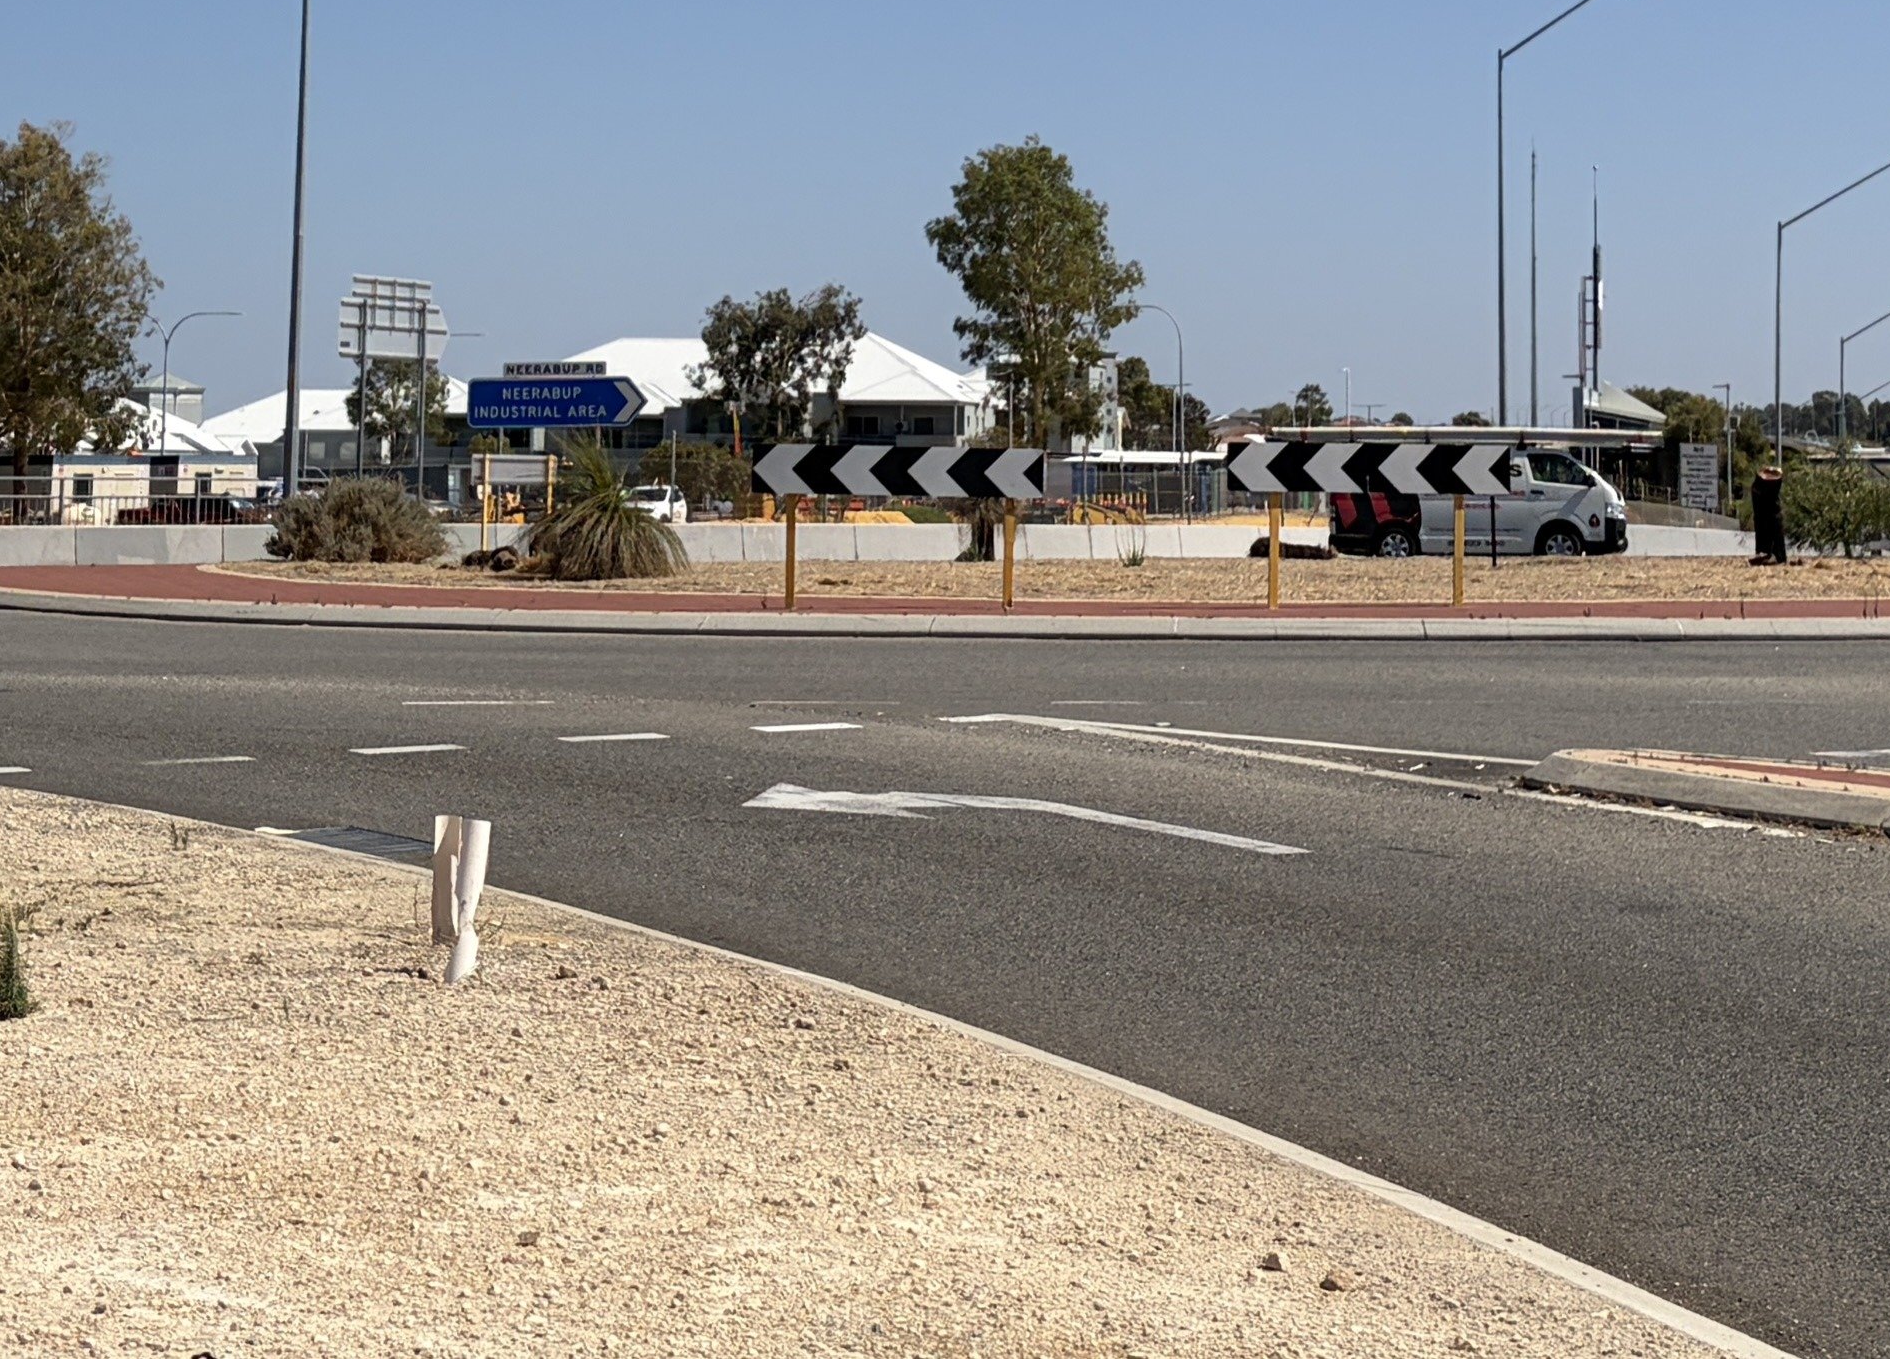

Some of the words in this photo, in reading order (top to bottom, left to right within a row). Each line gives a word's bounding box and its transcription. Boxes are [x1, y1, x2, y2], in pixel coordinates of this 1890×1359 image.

[505, 363, 581, 375] NEERABUP
[586, 363, 604, 374] RD
[502, 386, 582, 400] NEERABUP
[474, 406, 562, 418] INDUSTRIAL
[567, 405, 607, 418] AREA
